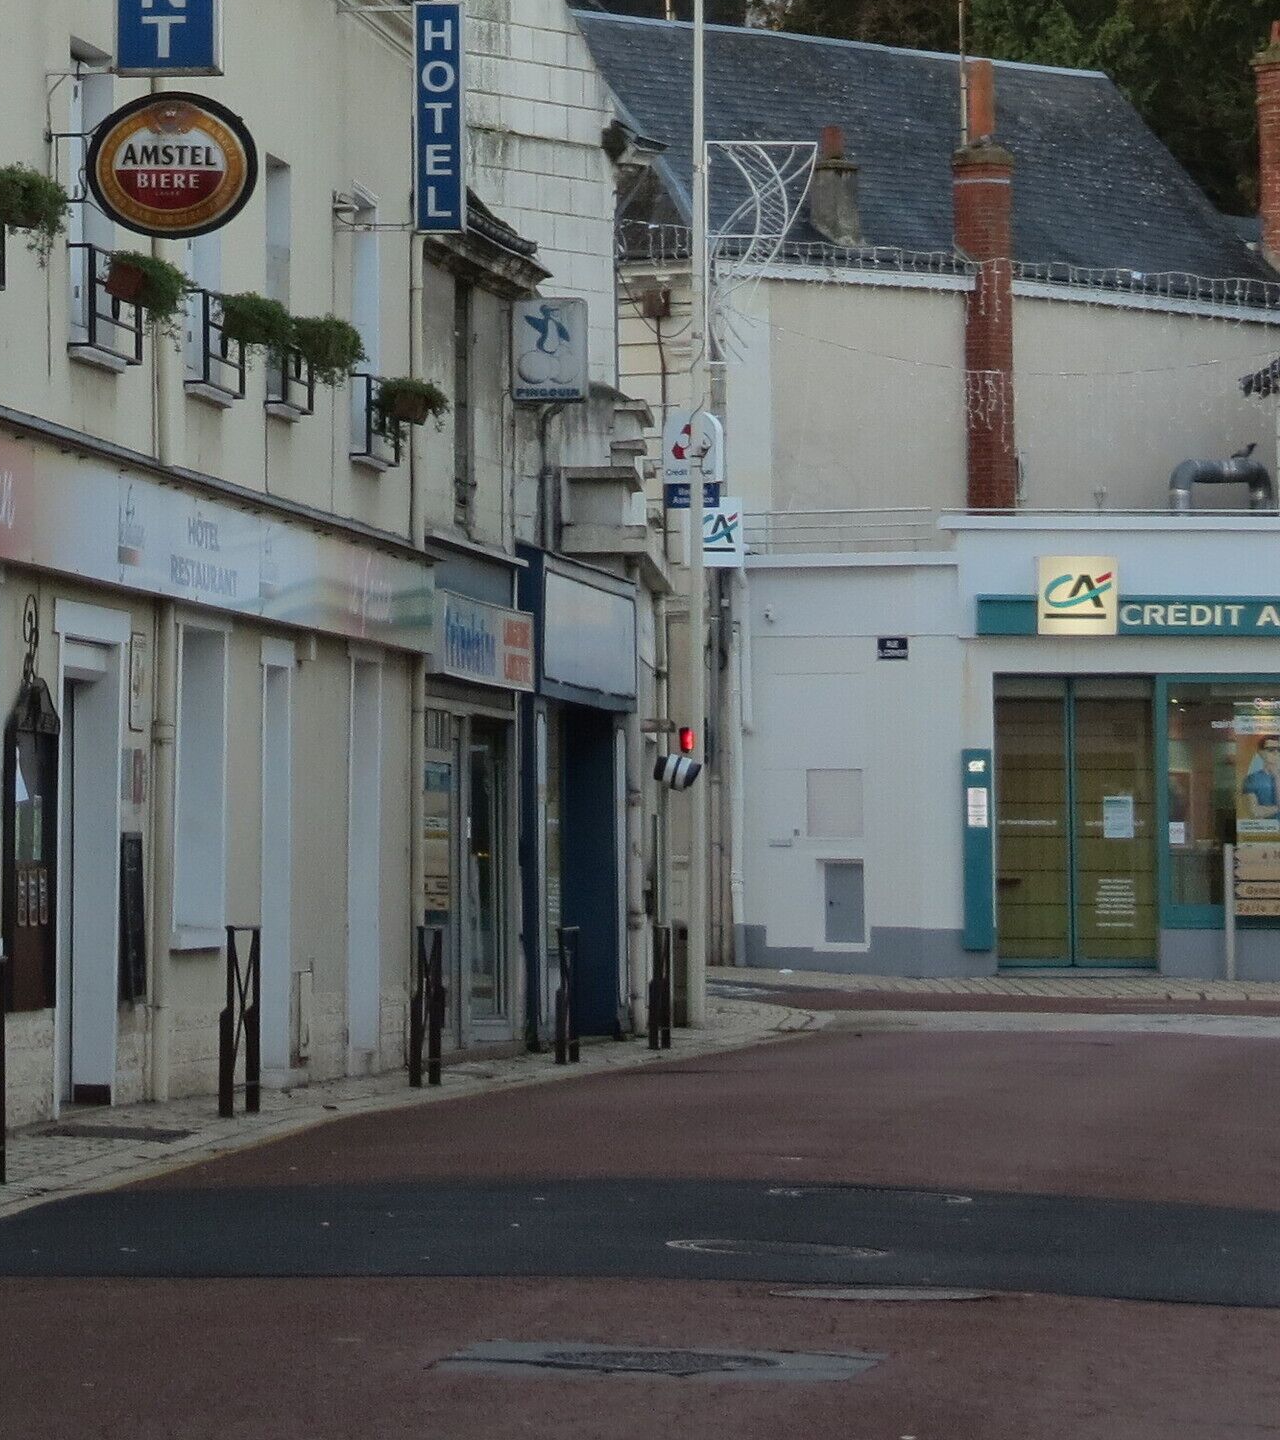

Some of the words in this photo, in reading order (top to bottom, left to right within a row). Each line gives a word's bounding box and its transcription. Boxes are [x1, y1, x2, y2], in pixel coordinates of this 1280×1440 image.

[422, 19, 455, 218] HOTEL
[122, 143, 216, 166] AMSTEL
[137, 172, 200, 189] BIERE
[187, 511, 220, 552] HÔTEL
[170, 553, 238, 597] RESTAURANT
[1119, 602, 1245, 627] CRÉDIT
